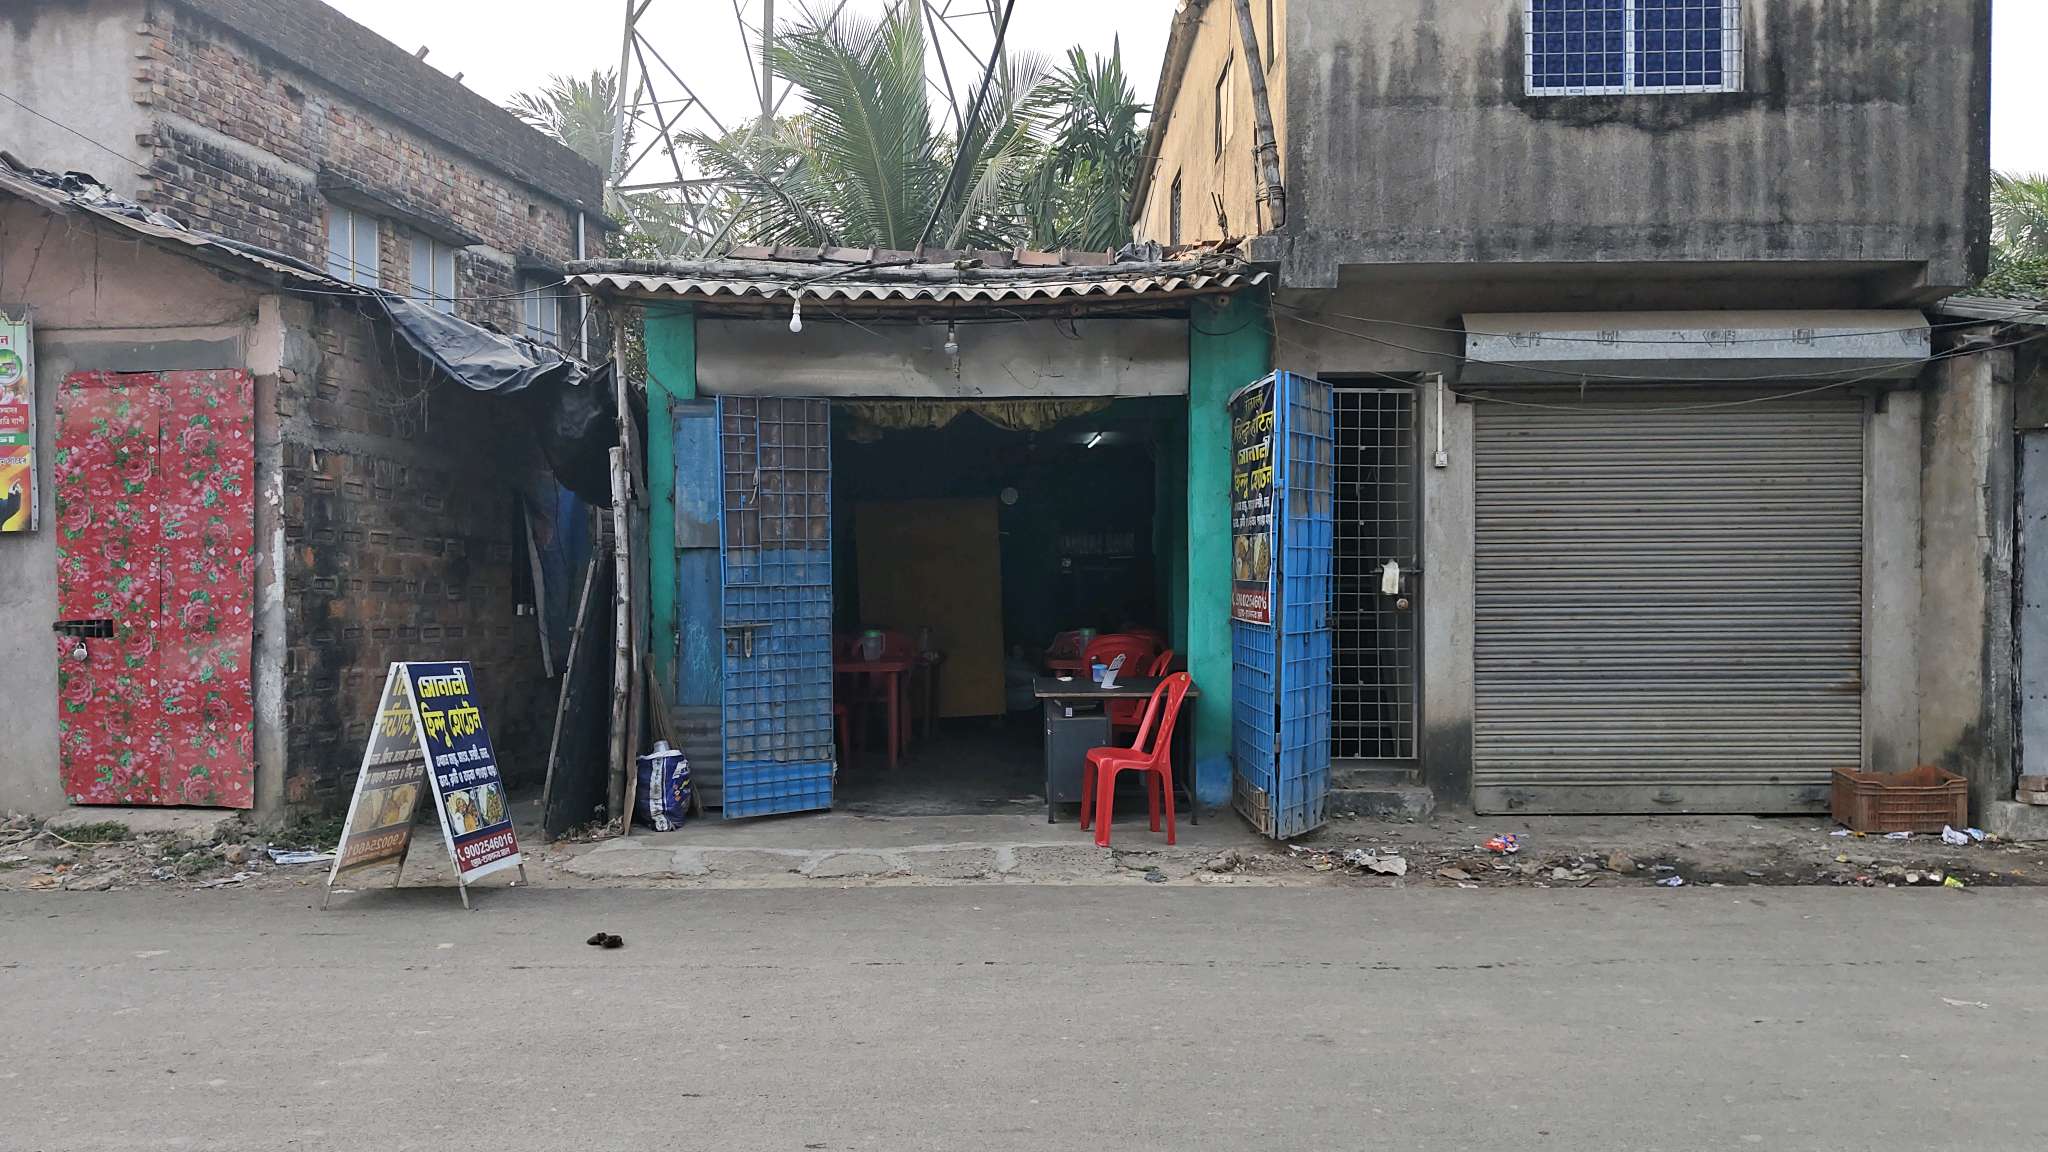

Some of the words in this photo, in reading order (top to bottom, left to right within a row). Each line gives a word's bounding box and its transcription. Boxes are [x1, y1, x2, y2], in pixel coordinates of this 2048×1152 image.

[418, 667, 469, 698] সোনালী
[420, 701, 454, 749] হিন্দু
[447, 698, 483, 739] হোটেল
[464, 832, 514, 859] 9002546016
